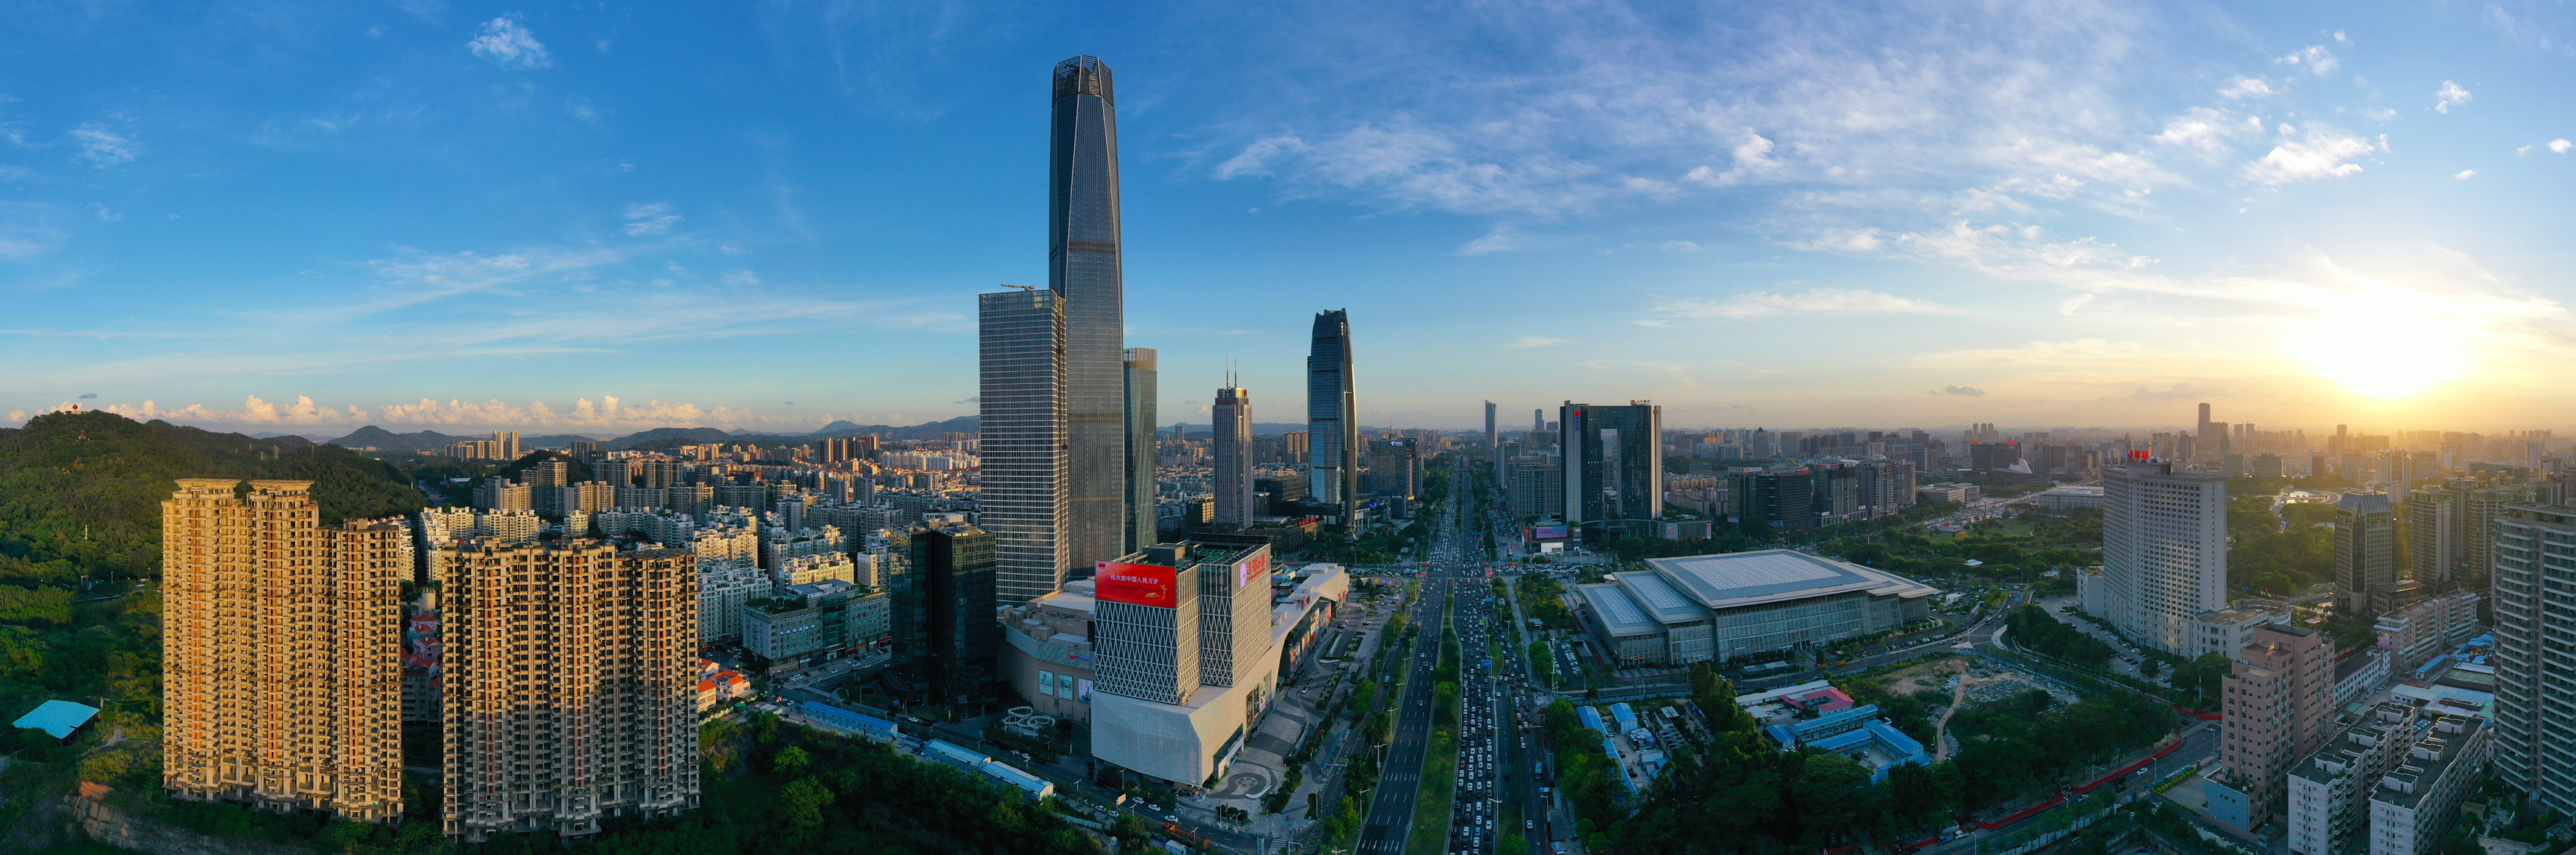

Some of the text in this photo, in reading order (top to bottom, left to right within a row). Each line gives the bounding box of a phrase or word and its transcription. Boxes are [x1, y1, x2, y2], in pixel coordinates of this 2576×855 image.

[1111, 574, 1159, 584] 伟大的中国人民万岁
